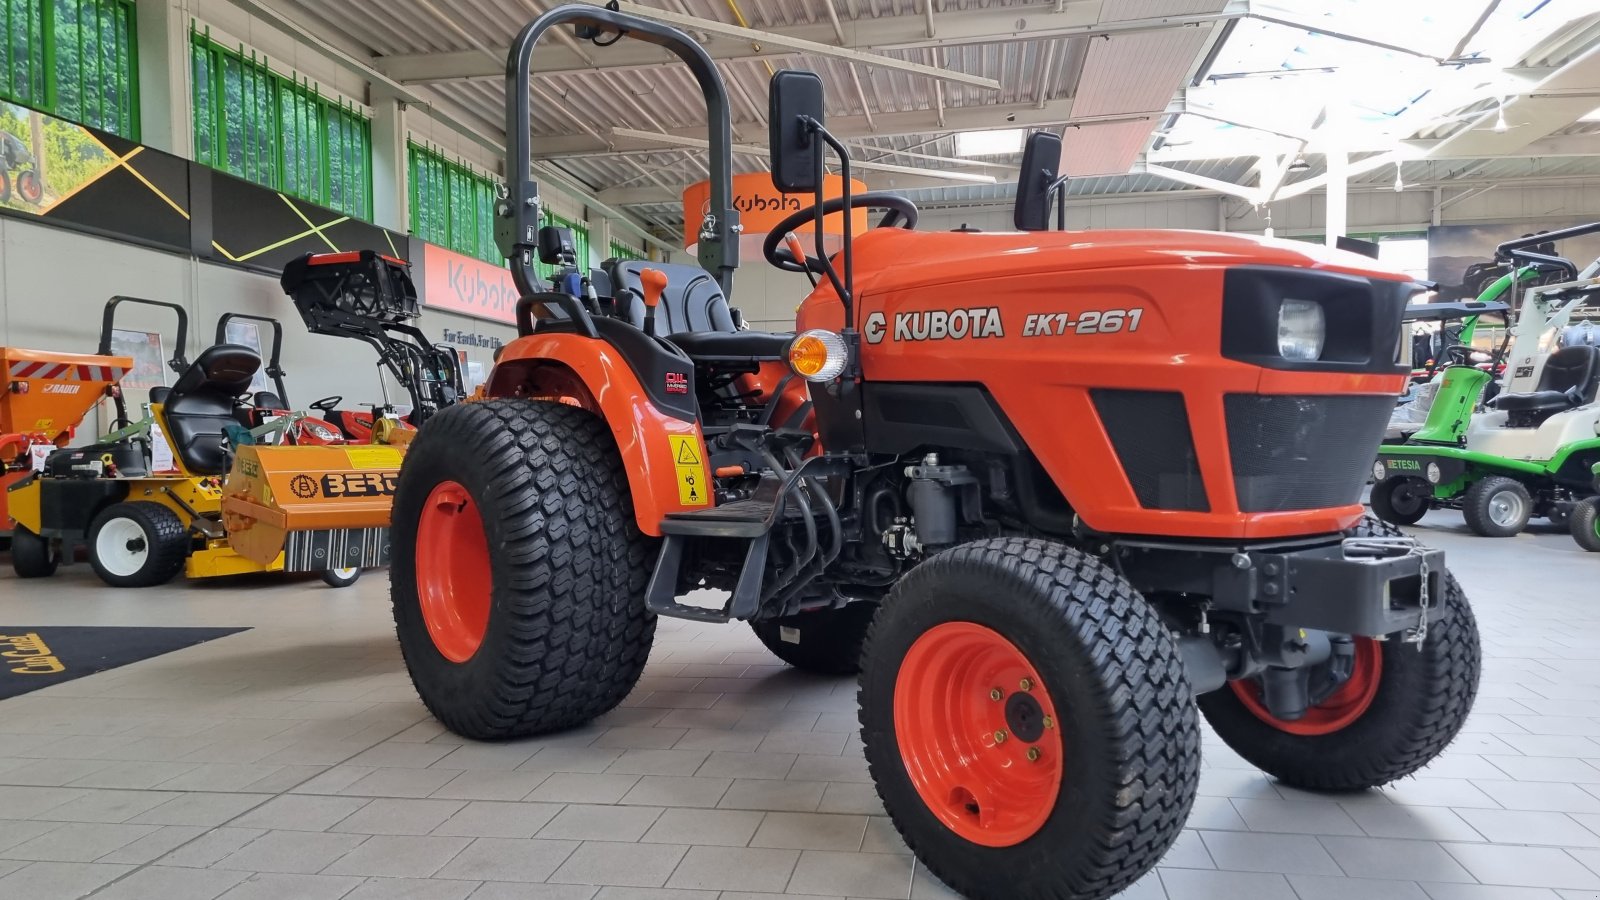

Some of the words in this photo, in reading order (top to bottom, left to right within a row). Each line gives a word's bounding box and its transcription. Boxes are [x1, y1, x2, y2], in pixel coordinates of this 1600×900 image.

[733, 193, 801, 212] Kubota
[448, 260, 517, 313] Kubota
[894, 306, 1004, 341] KUBOTA
[1022, 308, 1144, 337] EK1-261
[1392, 460, 1421, 470] ETESIA
[7, 656, 66, 674] Cub
